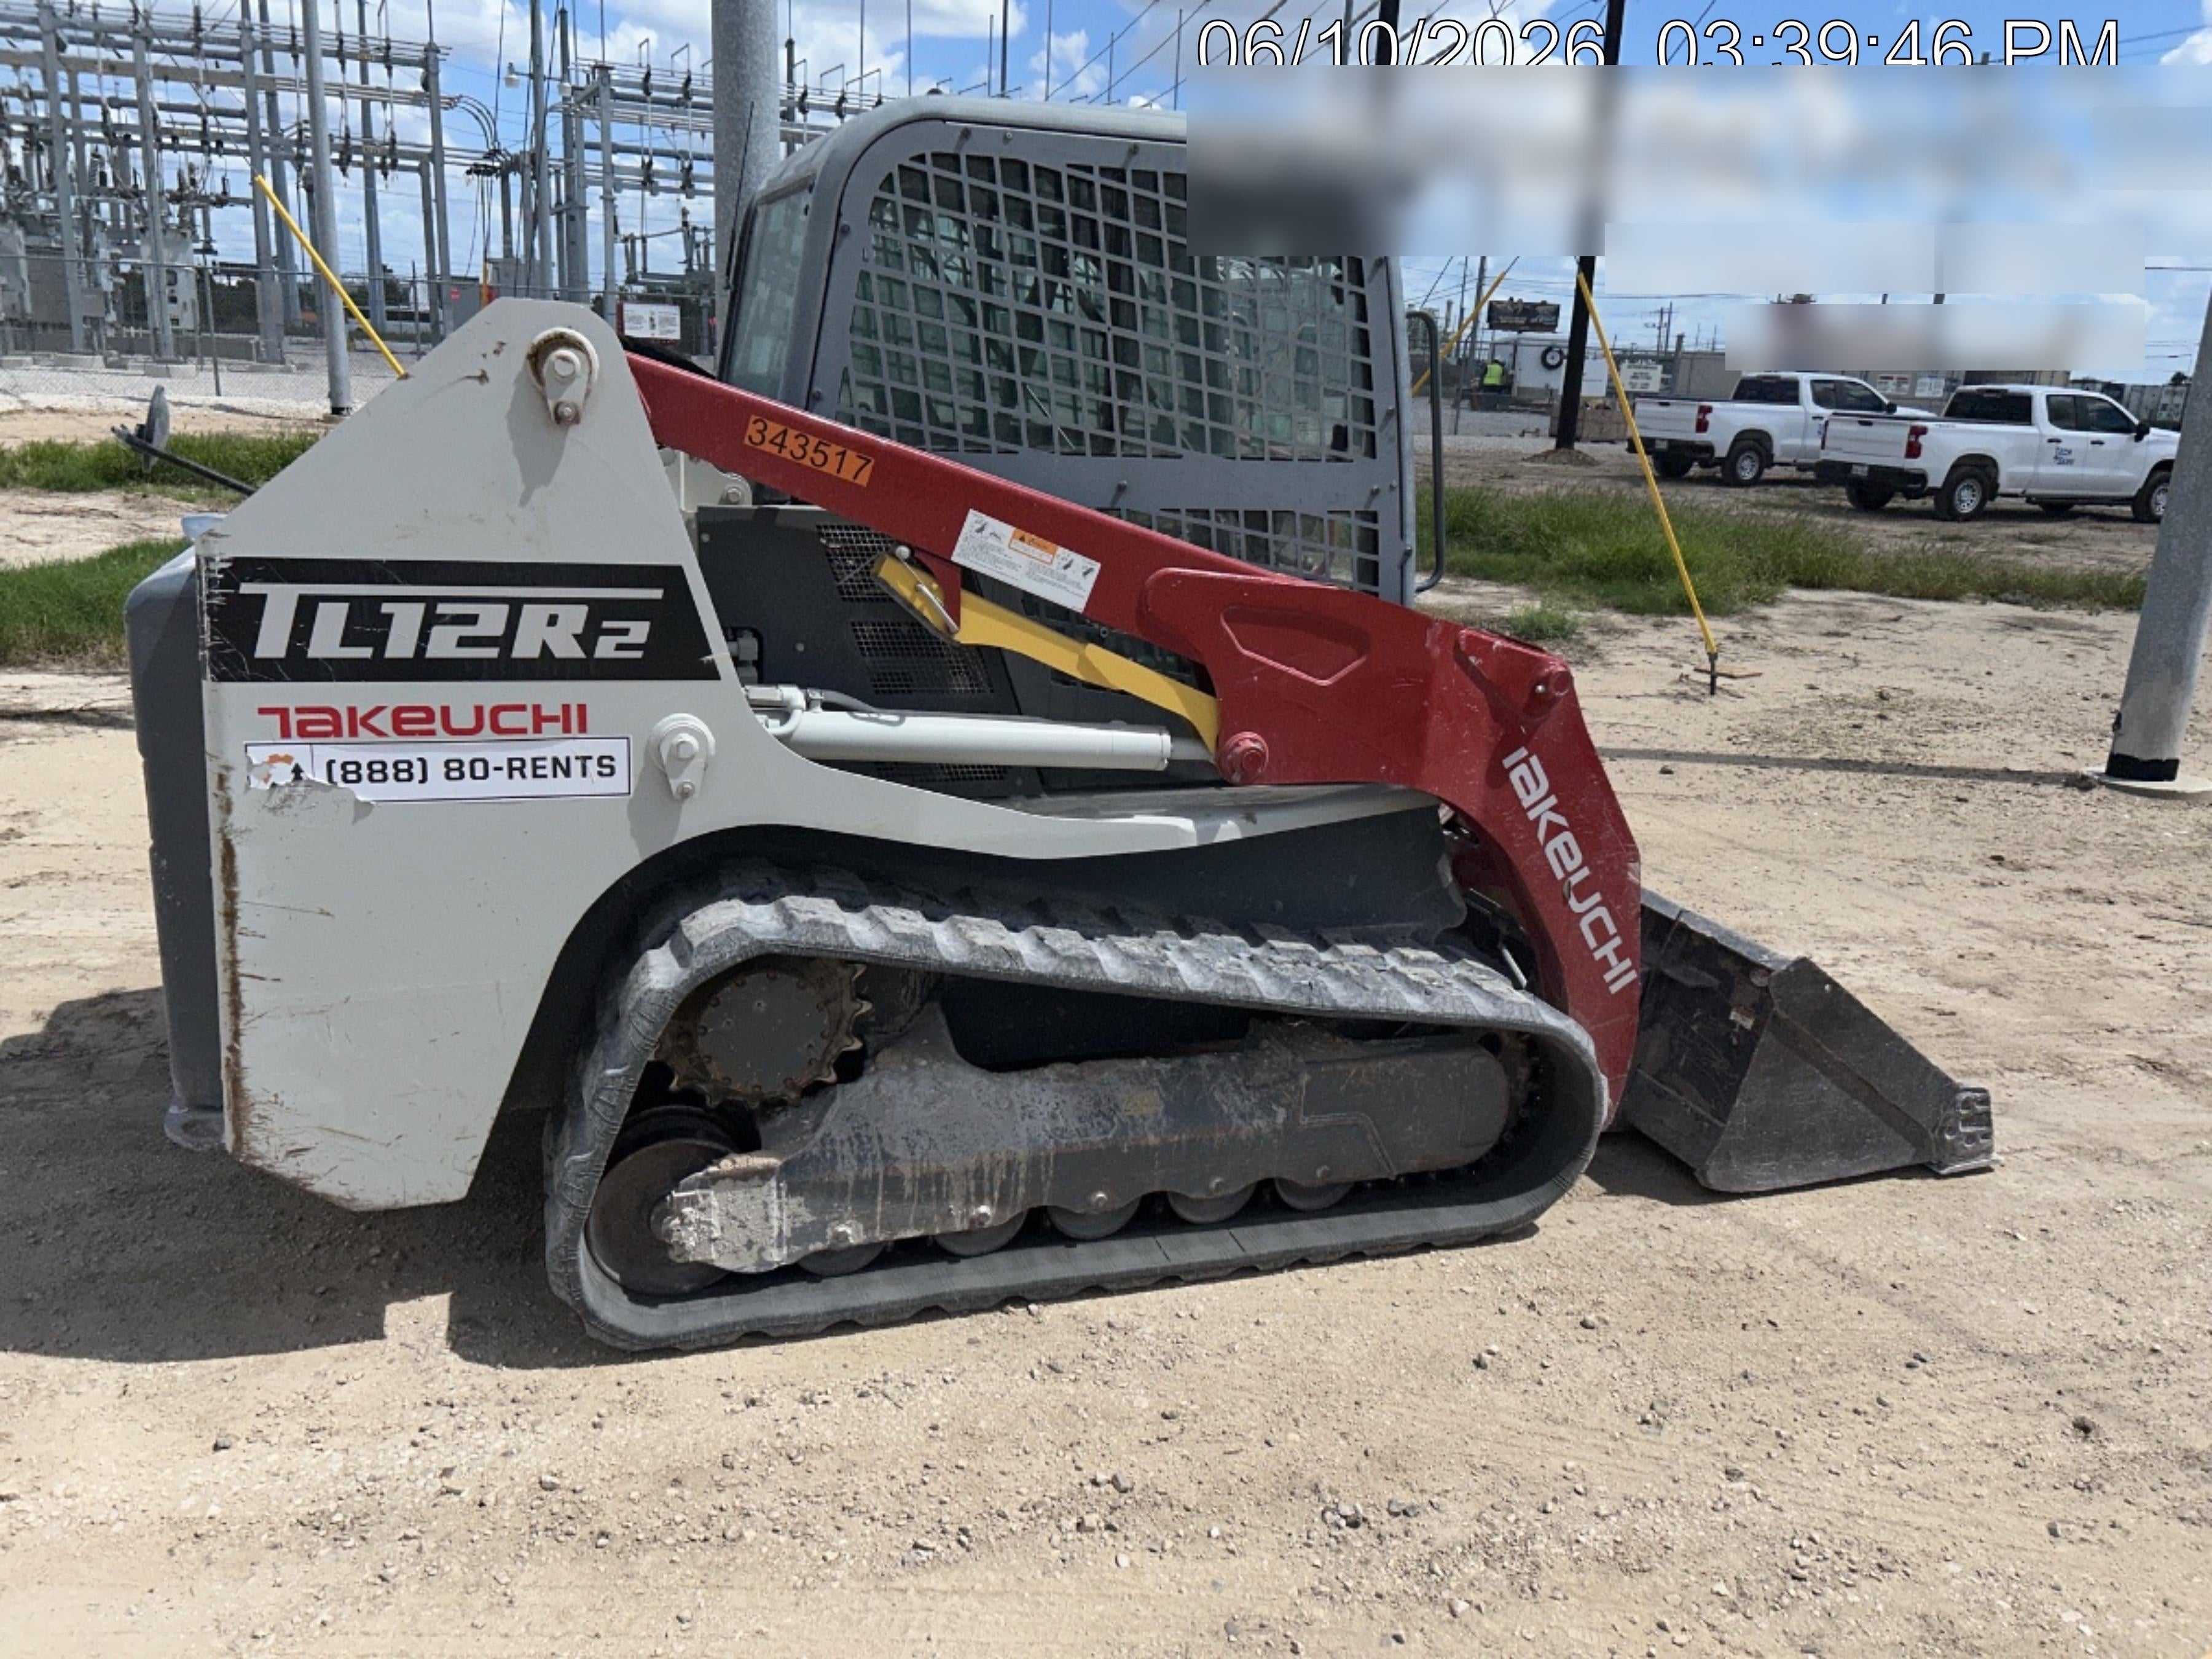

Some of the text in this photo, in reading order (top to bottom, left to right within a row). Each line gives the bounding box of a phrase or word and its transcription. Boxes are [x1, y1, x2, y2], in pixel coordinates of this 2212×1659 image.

[748, 418, 873, 482] 343517
[326, 755, 616, 785] (888) 80-RENTS
